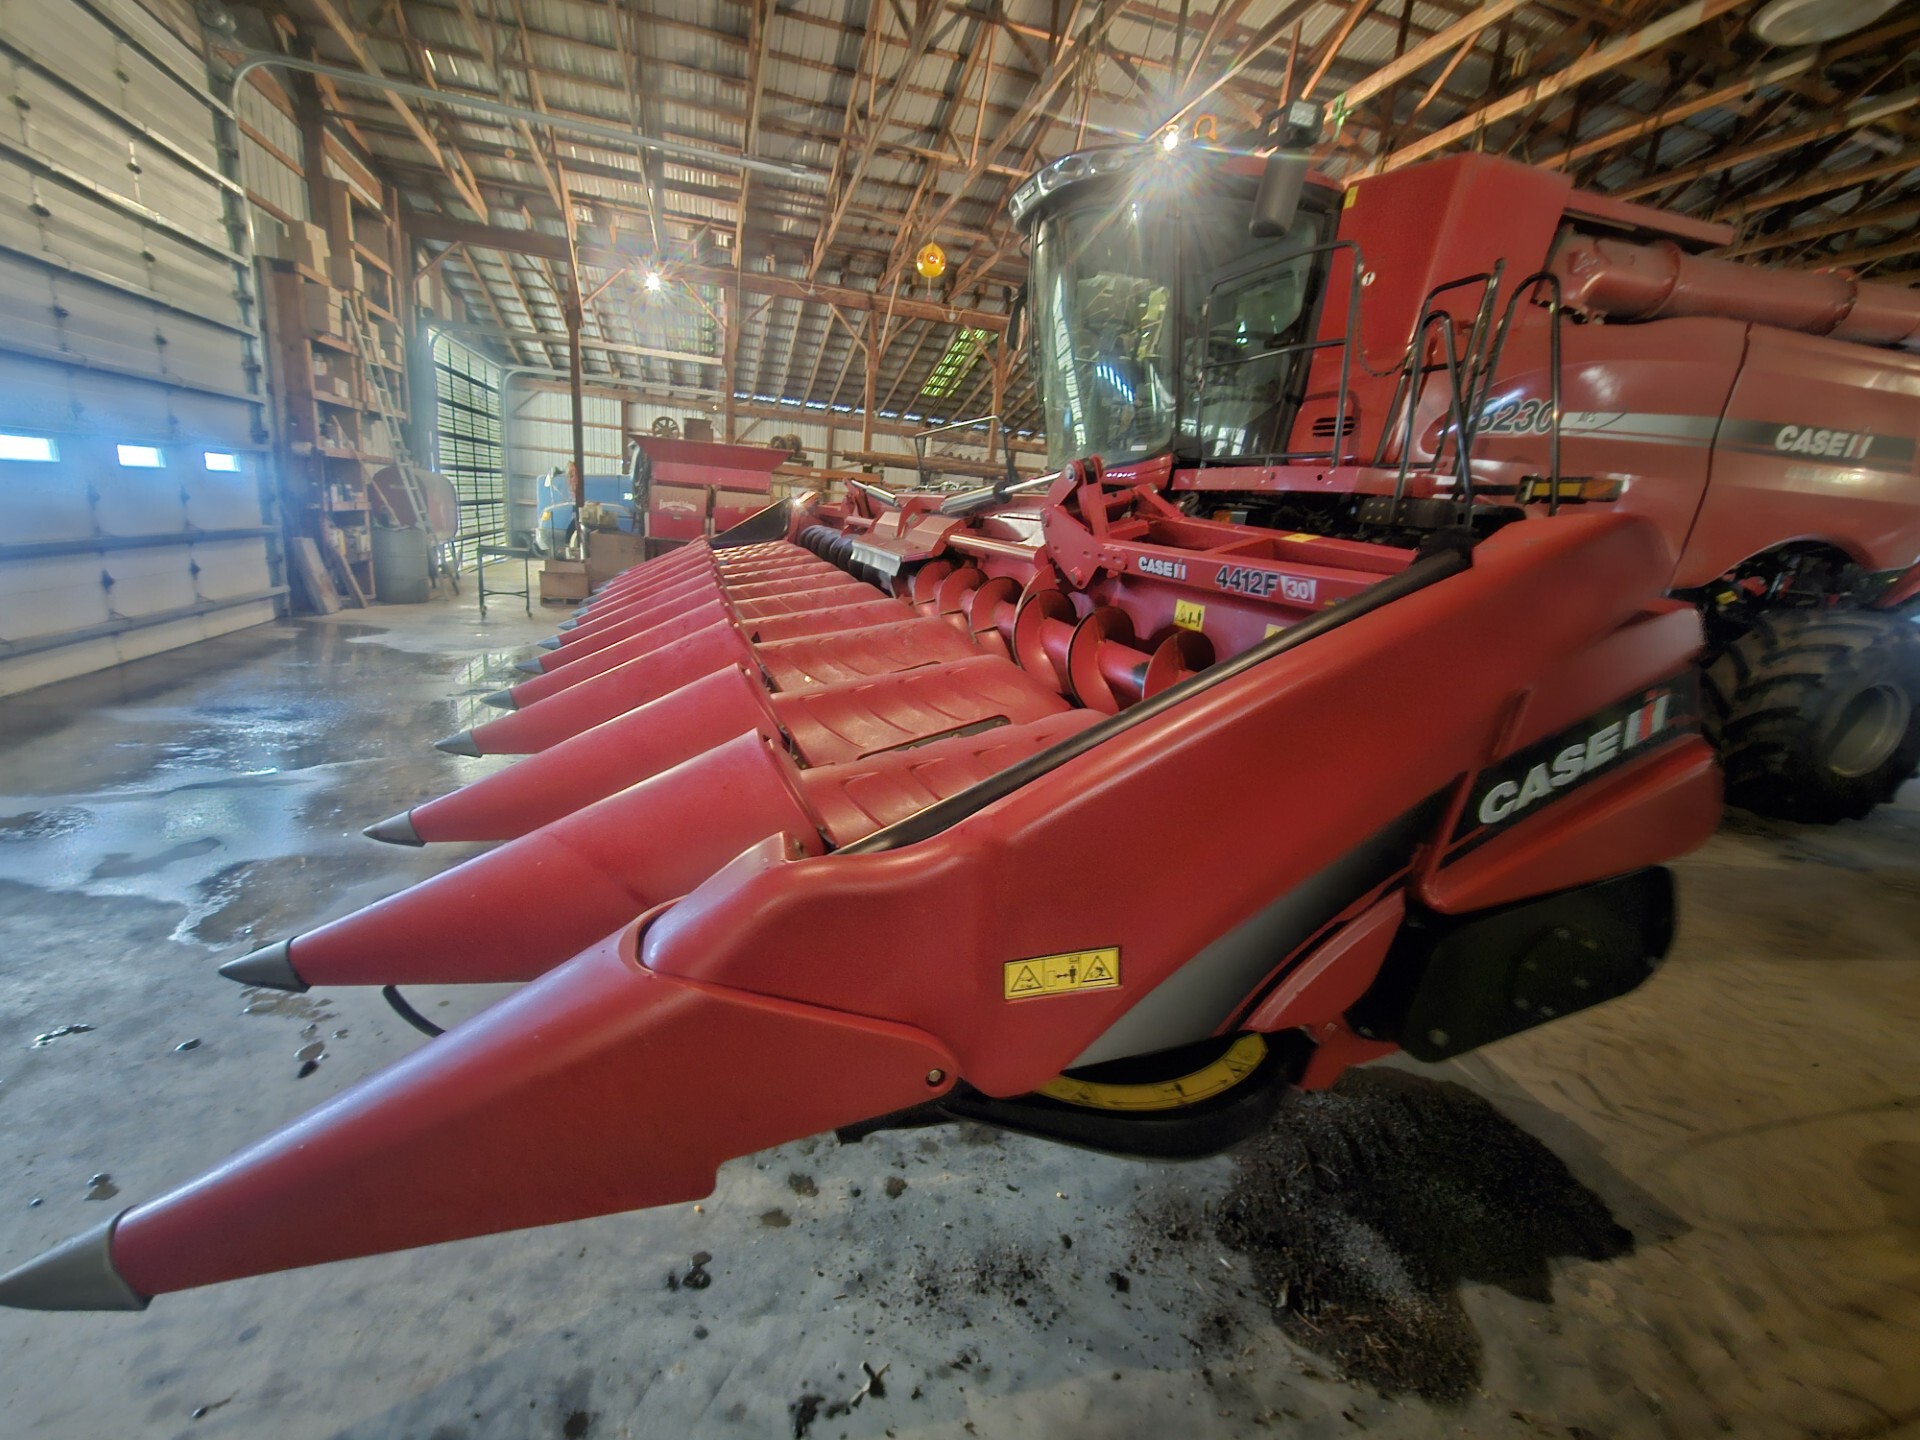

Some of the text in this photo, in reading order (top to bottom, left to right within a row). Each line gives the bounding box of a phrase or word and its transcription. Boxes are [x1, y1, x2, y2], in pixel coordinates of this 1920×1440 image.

[1215, 565, 1309, 599] 4412F 30
[1478, 720, 1623, 823] CASE
